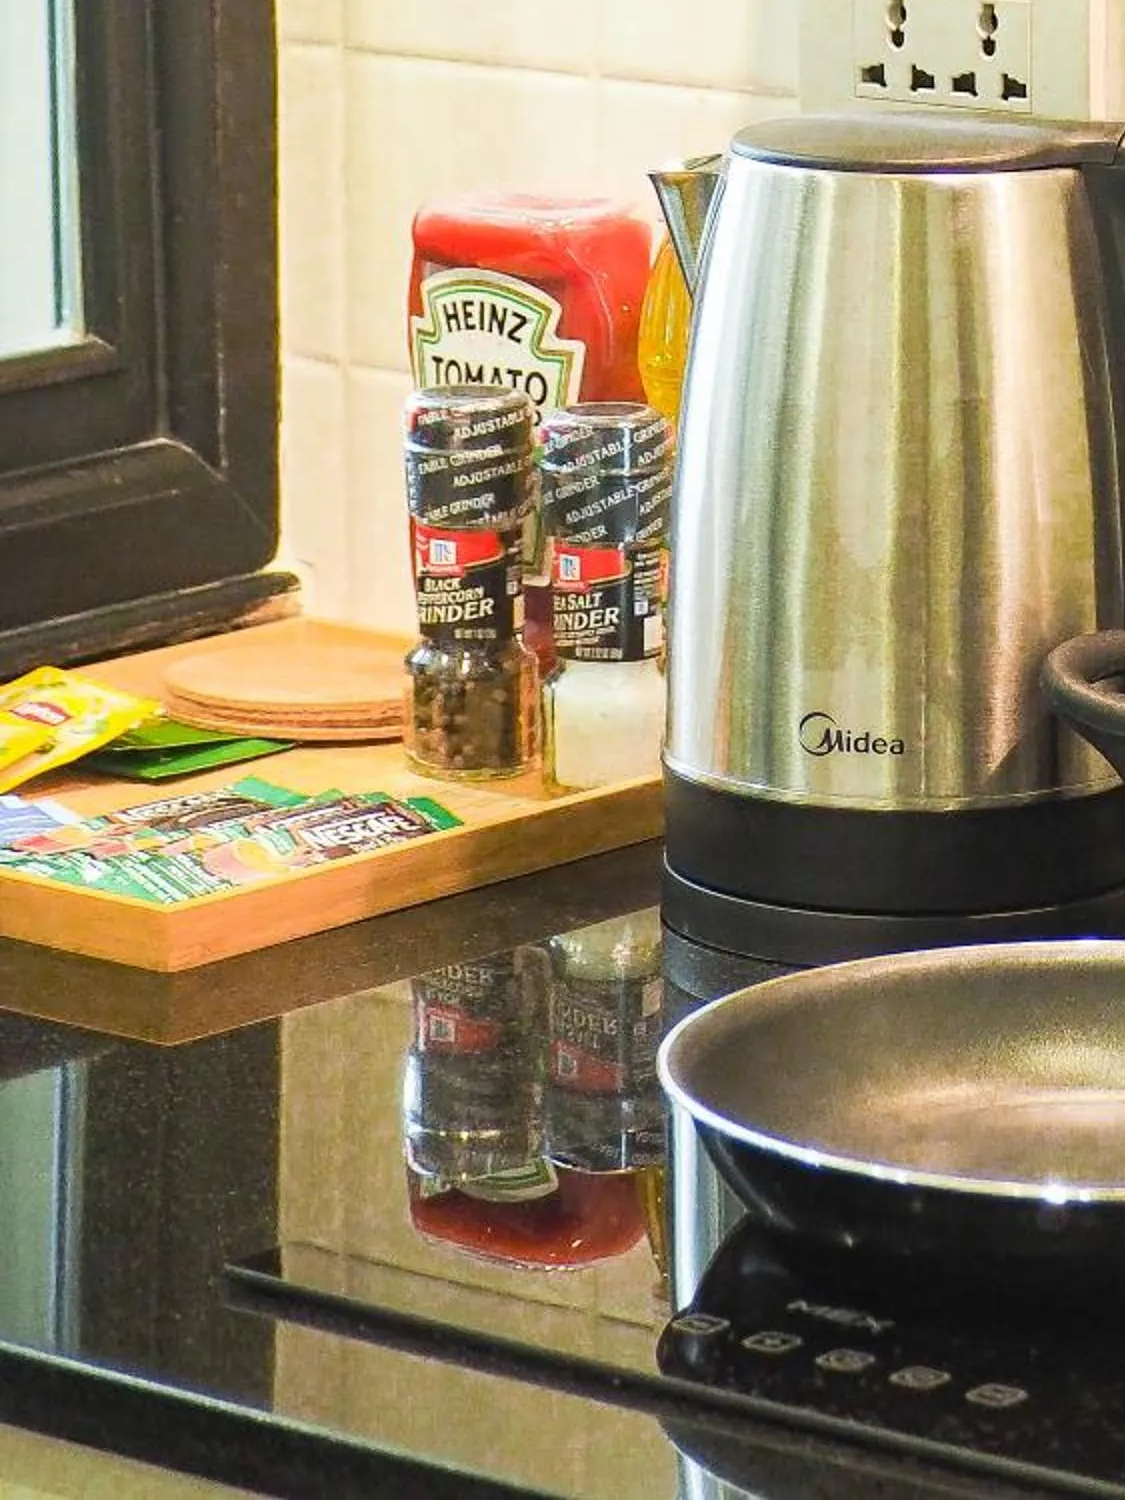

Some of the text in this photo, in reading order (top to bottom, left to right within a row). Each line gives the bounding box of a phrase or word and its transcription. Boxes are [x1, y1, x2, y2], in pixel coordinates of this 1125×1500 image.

[442, 300, 528, 343] HEINZ
[431, 355, 549, 406] TOMATO
[424, 577, 462, 593] BLACK
[567, 592, 603, 612] SALT
[800, 713, 905, 756] Midea
